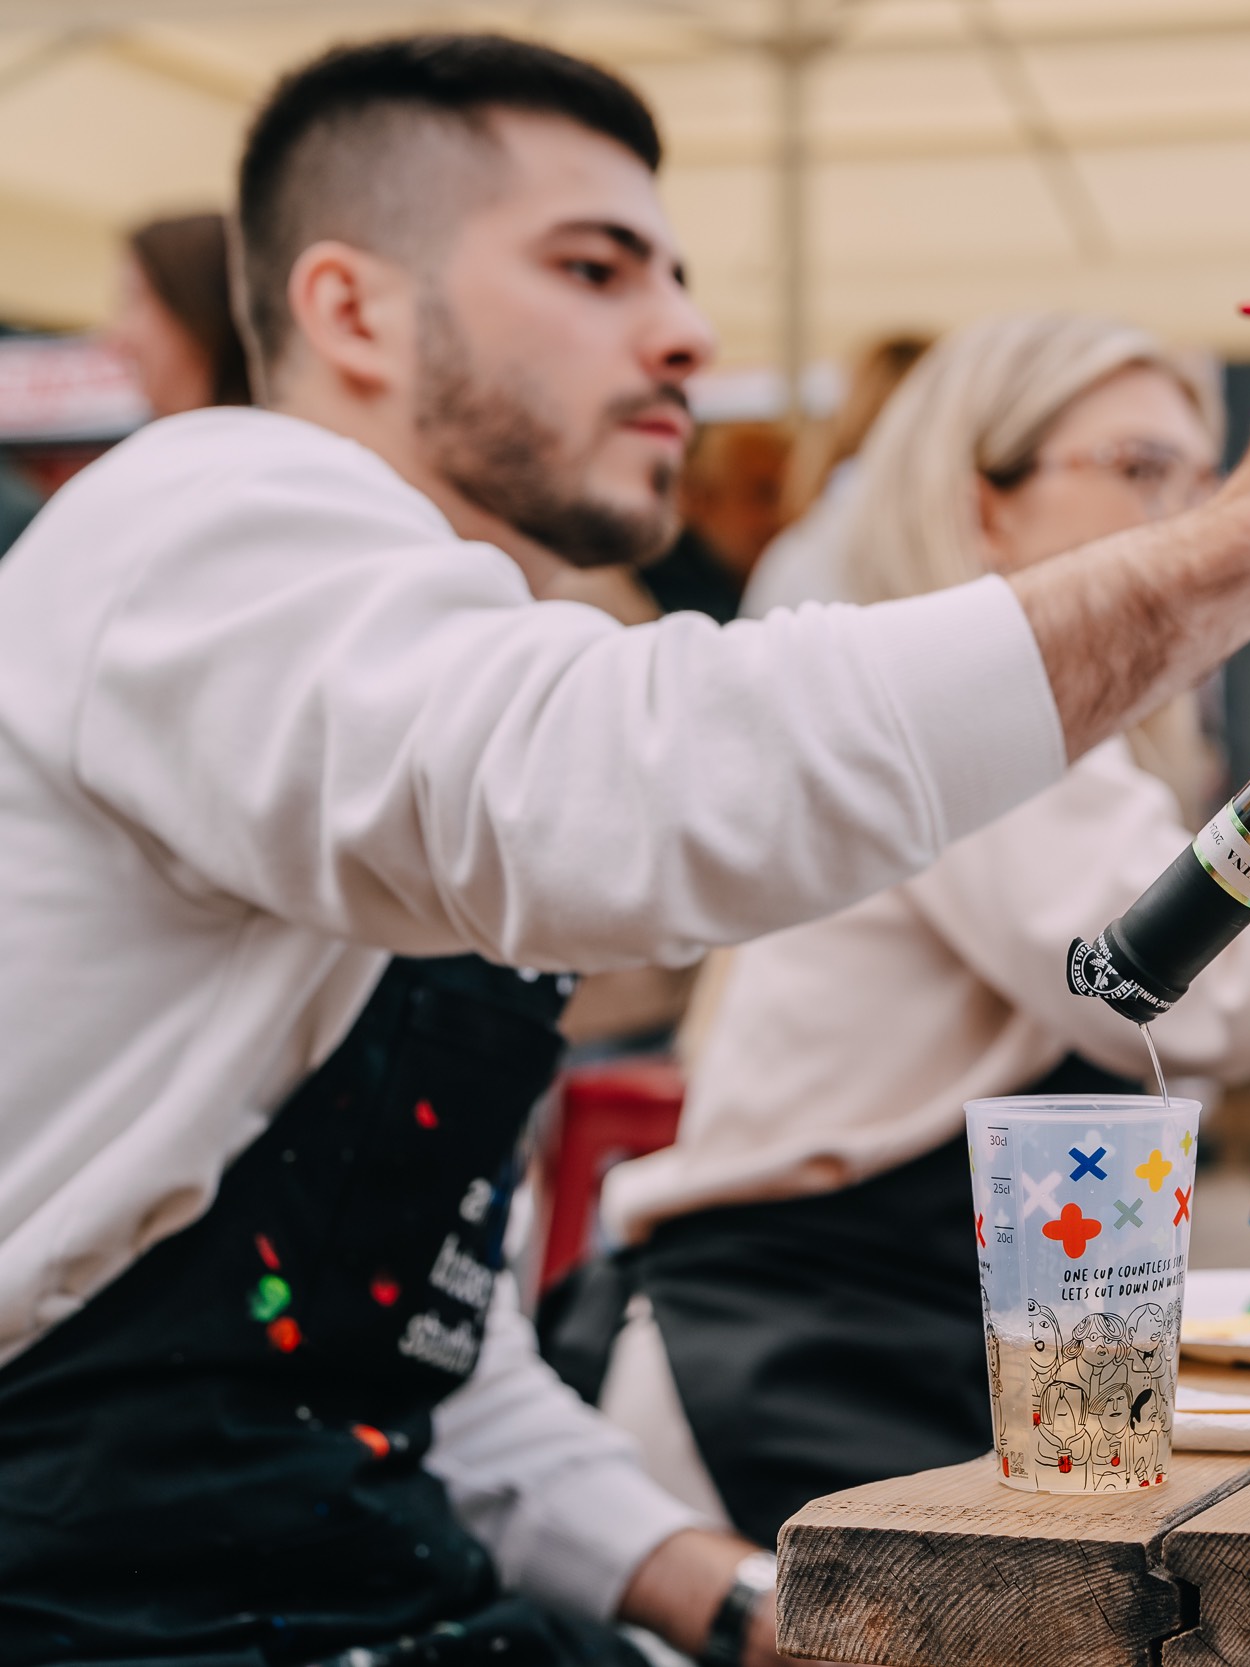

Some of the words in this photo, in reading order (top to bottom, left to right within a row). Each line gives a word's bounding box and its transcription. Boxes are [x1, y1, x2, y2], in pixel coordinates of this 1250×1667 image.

[1076, 944, 1092, 962] 1992
[1074, 964, 1088, 992] SINCE
[990, 1135, 1007, 1146] 30cl
[994, 1183, 1010, 1194] 25cl
[997, 1232, 1013, 1244] 20cl
[1064, 1268, 1088, 1282] ONE
[1094, 1267, 1113, 1279] CUP
[1118, 1259, 1170, 1278] COUNTLESS
[1062, 1288, 1089, 1300] LETS
[1094, 1285, 1114, 1298] CUT
[1119, 1280, 1148, 1296] DOWN
[1152, 1278, 1164, 1292] ON
